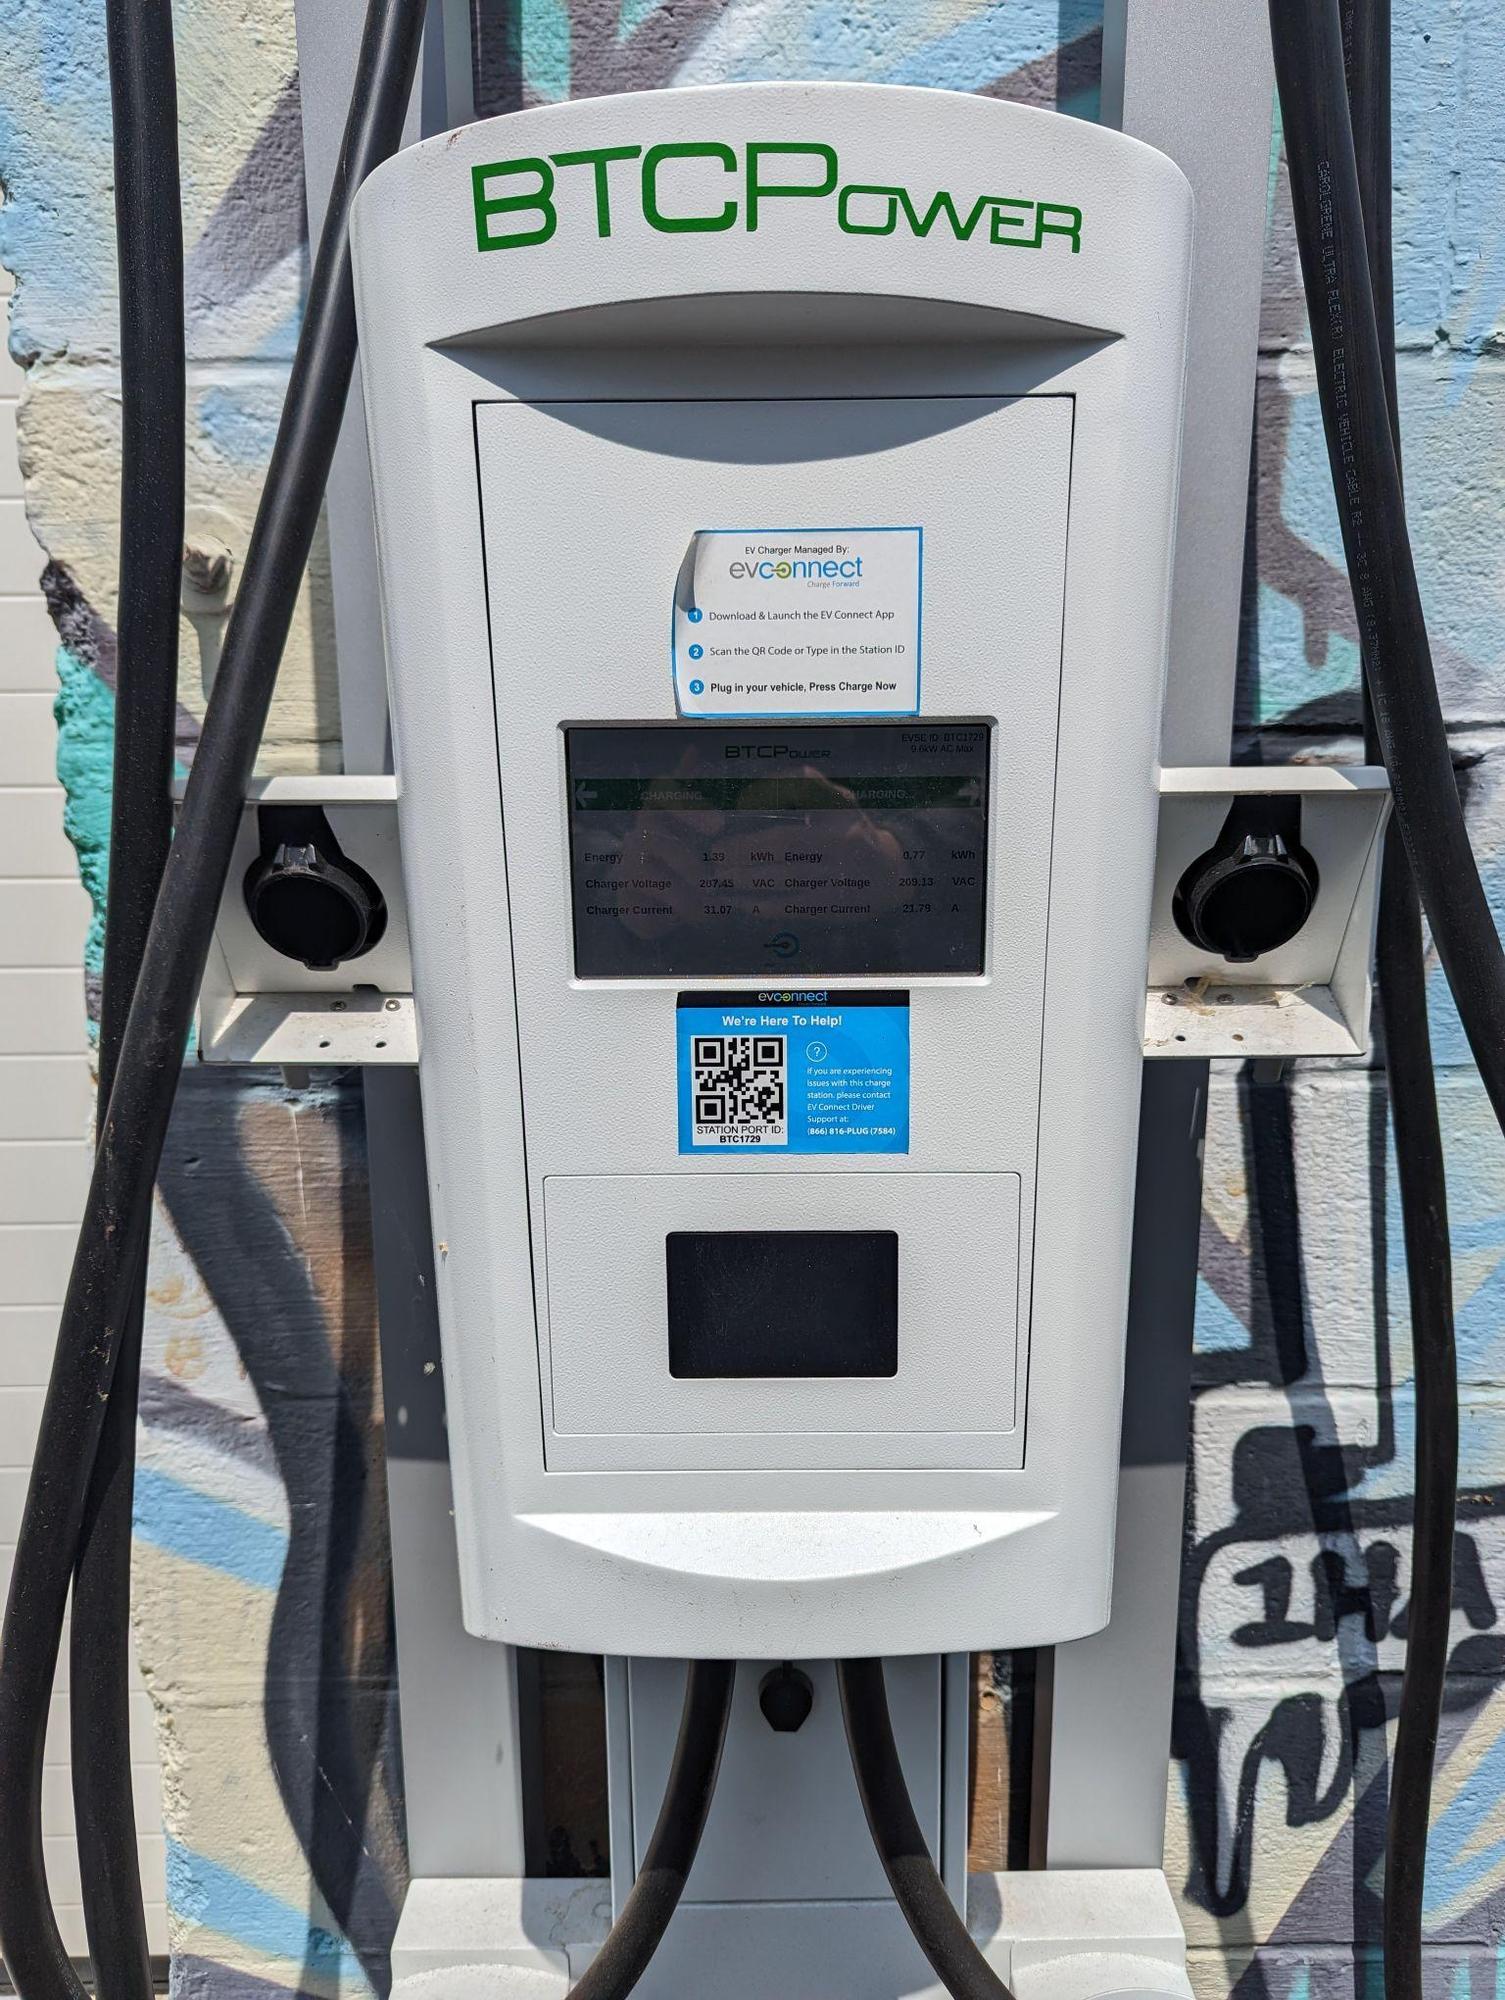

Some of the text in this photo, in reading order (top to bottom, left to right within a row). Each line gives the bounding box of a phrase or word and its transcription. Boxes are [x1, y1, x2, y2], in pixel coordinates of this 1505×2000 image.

[1332, 348, 1348, 408] ELECTRIC
[1337, 414, 1354, 464] VEHICLE
[745, 545, 850, 557] EV Charger Managed By:
[807, 580, 860, 589] Charge Forward
[709, 611, 758, 621] Download
[758, 611, 766, 621] &
[767, 611, 802, 621] Launch
[803, 610, 819, 621] the
[820, 610, 833, 620] EV
[834, 610, 873, 620] Connect
[875, 610, 895, 622] App
[710, 647, 732, 656] Scan
[734, 647, 750, 656] the
[752, 646, 766, 657] QR
[768, 645, 792, 656] Code
[794, 647, 804, 655] or
[806, 646, 829, 658] Type
[830, 645, 840, 655] in
[842, 645, 858, 655] the
[859, 644, 893, 655] Station
[894, 644, 905, 654] ID
[710, 682, 732, 695] Plug
[734, 682, 744, 693] in
[746, 684, 768, 695] your
[769, 682, 807, 694] vehicle,
[809, 681, 836, 692] Press
[838, 681, 873, 694] Charge
[875, 681, 897, 691] Now
[956, 744, 975, 753] Max
[584, 852, 623, 865] Energy
[750, 851, 774, 862] kWh
[784, 850, 976, 864] Energy 0.77 kWh
[585, 879, 629, 891] Charger
[632, 878, 672, 891] Voltage
[752, 878, 775, 888] VAC
[784, 878, 828, 890] Charger
[831, 878, 871, 890] Voltage
[952, 877, 976, 887] VAC
[586, 905, 629, 917] Charger
[632, 905, 673, 915] Current
[752, 905, 760, 915] A
[784, 904, 828, 916] Charger
[830, 904, 871, 914] Current
[951, 904, 960, 913] A
[722, 1015, 842, 1029] We're Here To Help!
[814, 1069, 828, 1077] you
[829, 1068, 842, 1076] are
[843, 1067, 893, 1077] experiencing
[807, 1079, 891, 1088] issues with this charge
[836, 1091, 861, 1101] please
[862, 1091, 891, 1099] contact
[807, 1103, 875, 1111] EV Connect Driver
[807, 1115, 849, 1125] Support at:
[697, 1125, 784, 1135] STATION PORT ID:
[807, 1127, 896, 1137] (866) 816-PLUG (7584)
[719, 1135, 761, 1144] BTC1729
